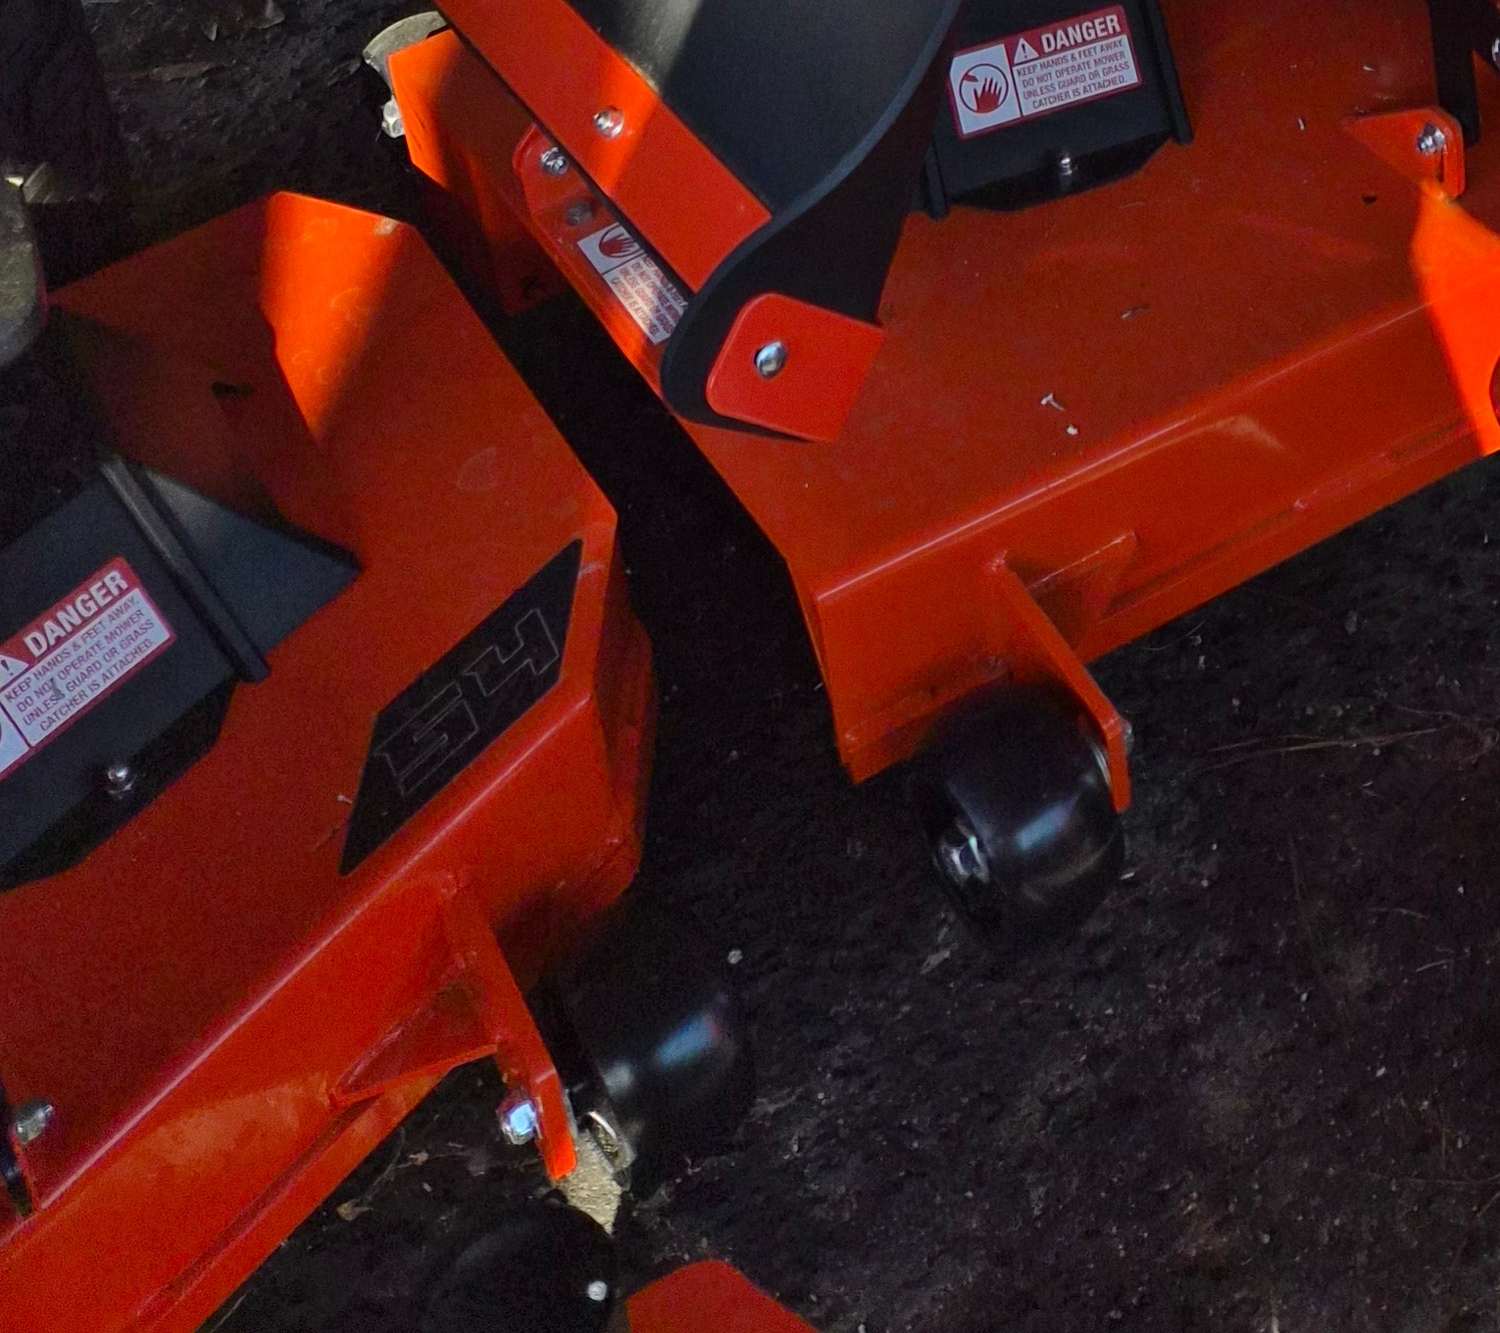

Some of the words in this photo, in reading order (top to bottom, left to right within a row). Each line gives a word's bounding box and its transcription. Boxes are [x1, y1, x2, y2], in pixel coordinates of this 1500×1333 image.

[1041, 14, 1121, 53] DANGER
[1016, 64, 1039, 78] KEEP
[1040, 54, 1070, 70] HANDS
[1078, 47, 1099, 61] FEET
[1021, 77, 1035, 89] DO
[1036, 72, 1054, 85] NOT
[1055, 61, 1092, 79] OPERATE
[1093, 51, 1127, 67] MOWER
[1022, 83, 1057, 100] UNLESS
[1058, 74, 1087, 90] GUARD
[1088, 70, 1102, 82] OR
[1102, 61, 1131, 77] GRASS
[1032, 90, 1072, 110] CATCHER
[23, 571, 128, 658] DANGER
[5, 677, 34, 703] KEEP
[33, 648, 71, 680] HANDS
[81, 622, 107, 644] FEET
[16, 696, 34, 713] DO
[33, 677, 56, 699] NOT
[58, 643, 105, 680] OPERATE
[104, 609, 145, 645] MOWER
[23, 691, 65, 726] UNLESS
[65, 661, 103, 693] GUARD
[102, 647, 120, 663] OR
[120, 619, 155, 650] GRASS
[39, 688, 89, 731] CATCHER
[89, 679, 101, 693] IS
[373, 608, 560, 796] 54
